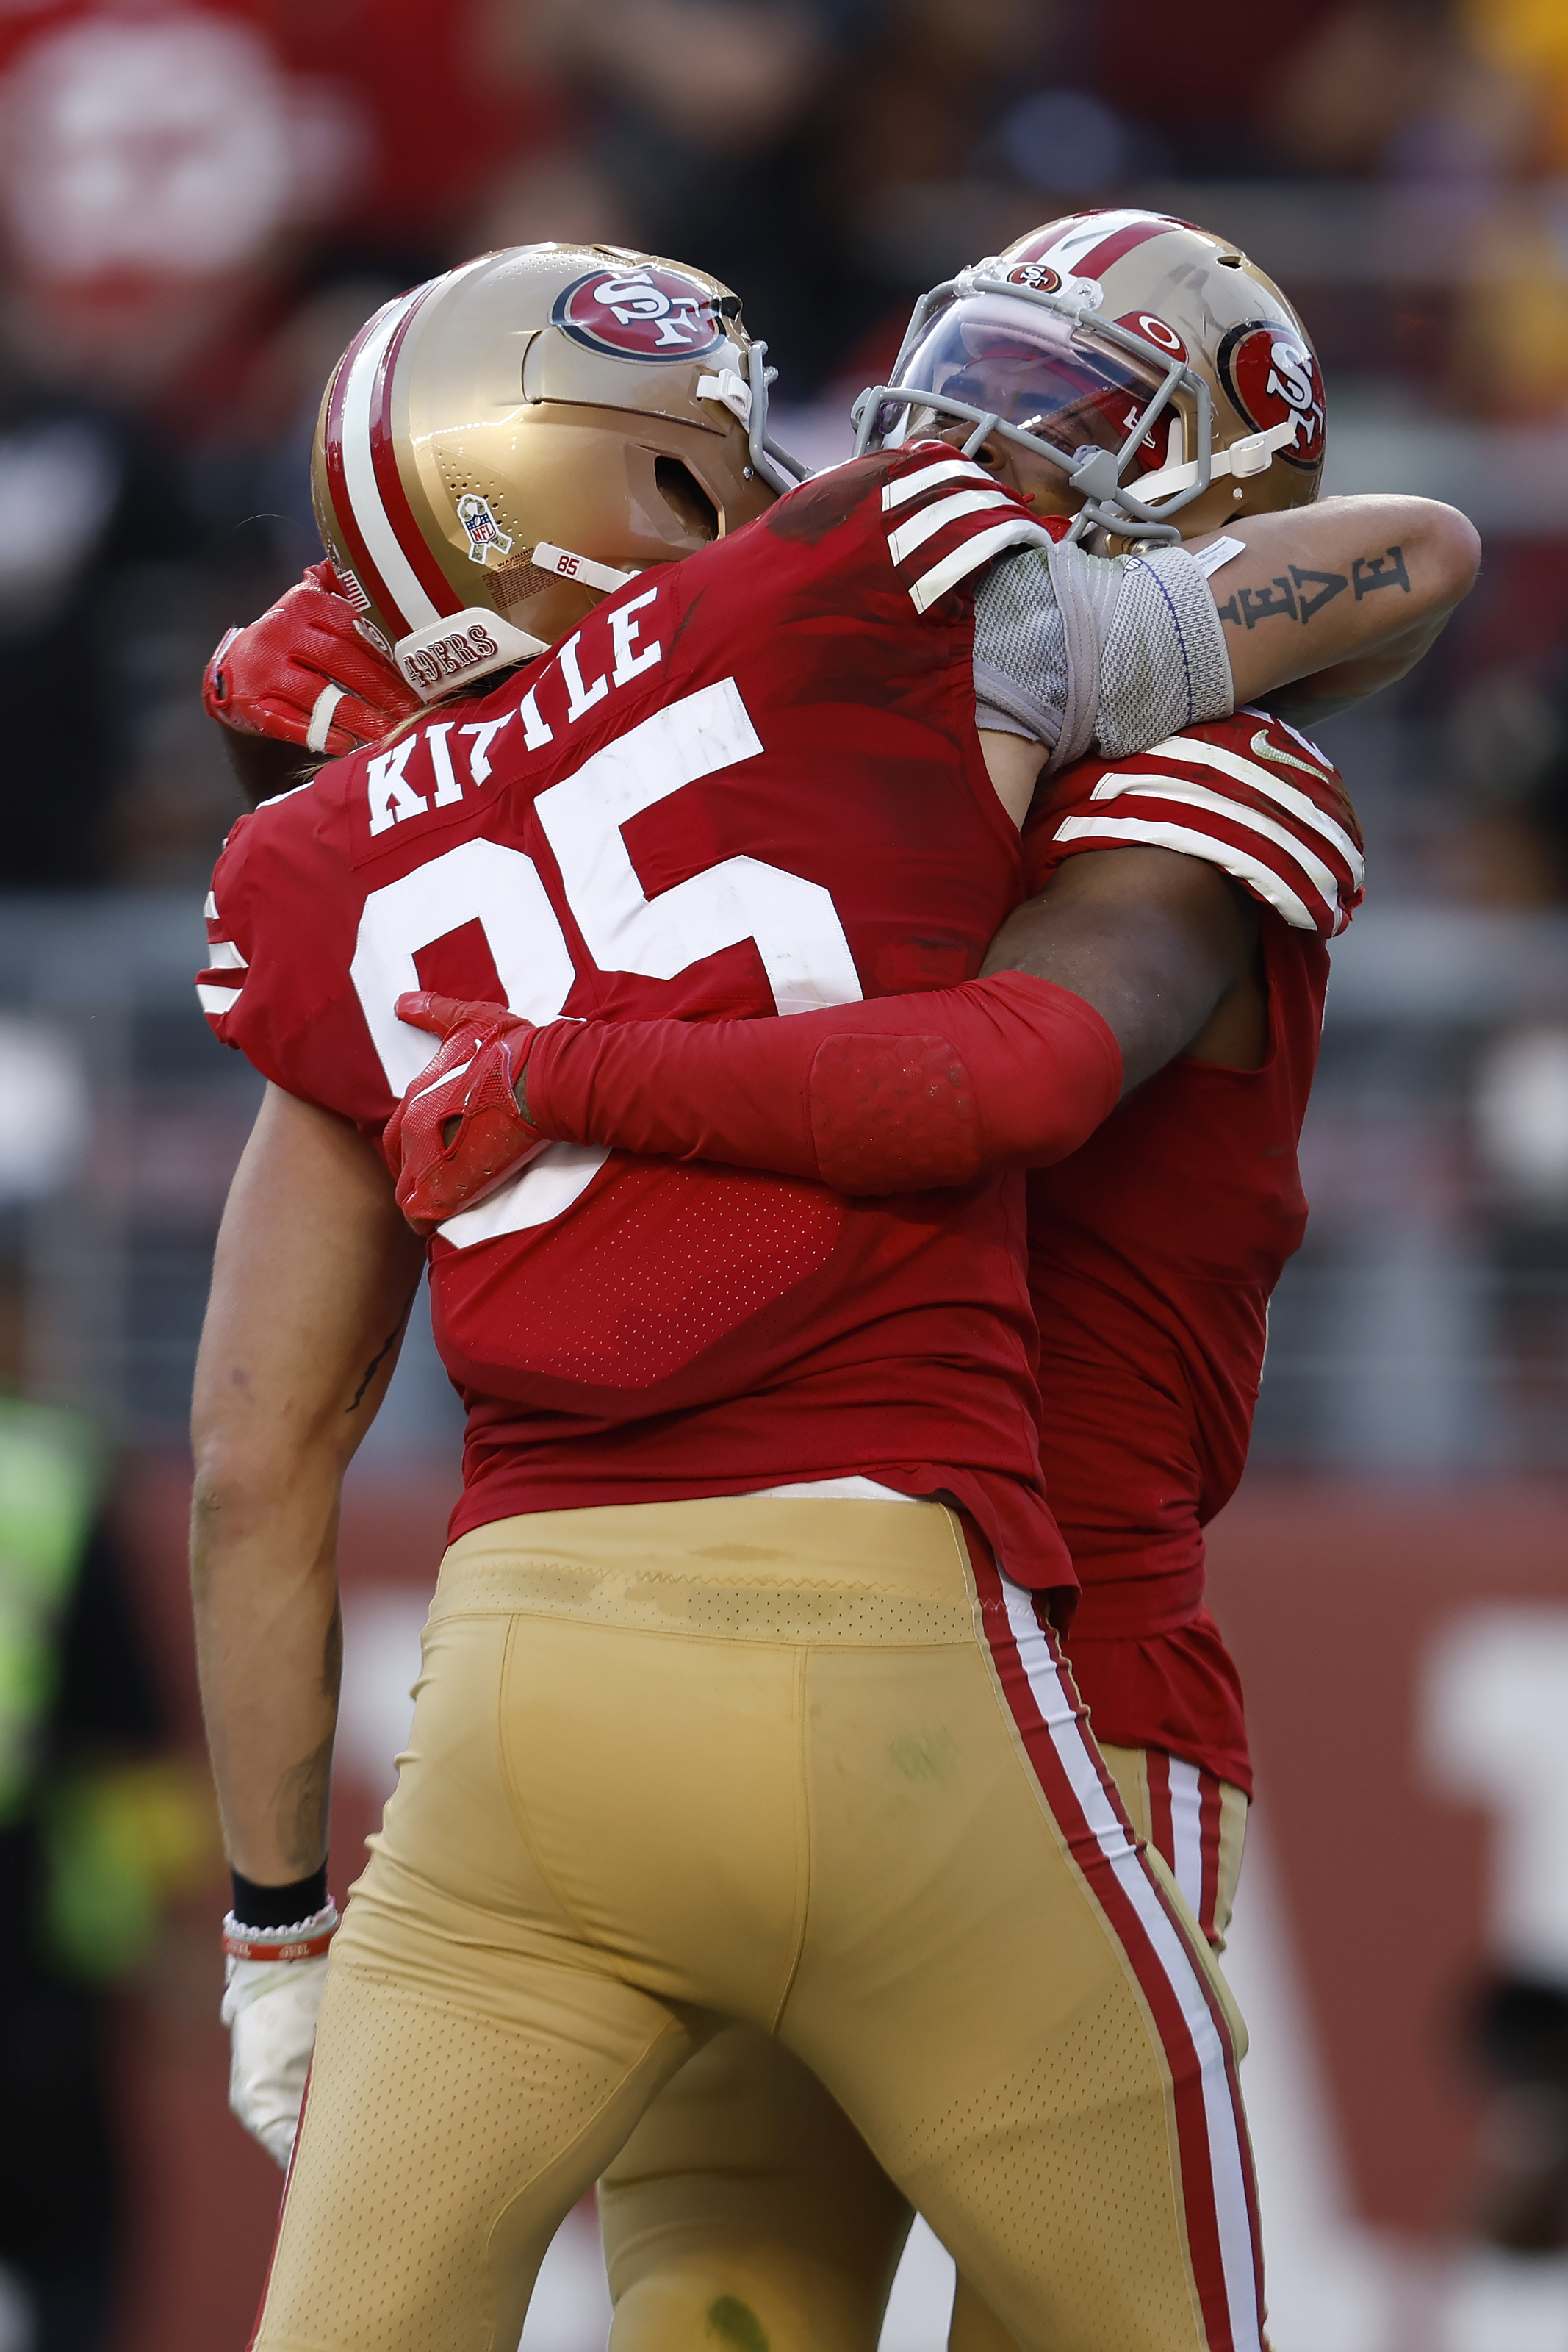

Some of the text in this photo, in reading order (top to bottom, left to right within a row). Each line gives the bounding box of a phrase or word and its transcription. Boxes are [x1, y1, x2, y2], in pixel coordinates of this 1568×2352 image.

[593, 273, 702, 348] SF
[471, 524, 494, 542] NFL
[557, 555, 580, 576] 85
[403, 623, 499, 688] 49ERS
[349, 676, 865, 1250] 85
